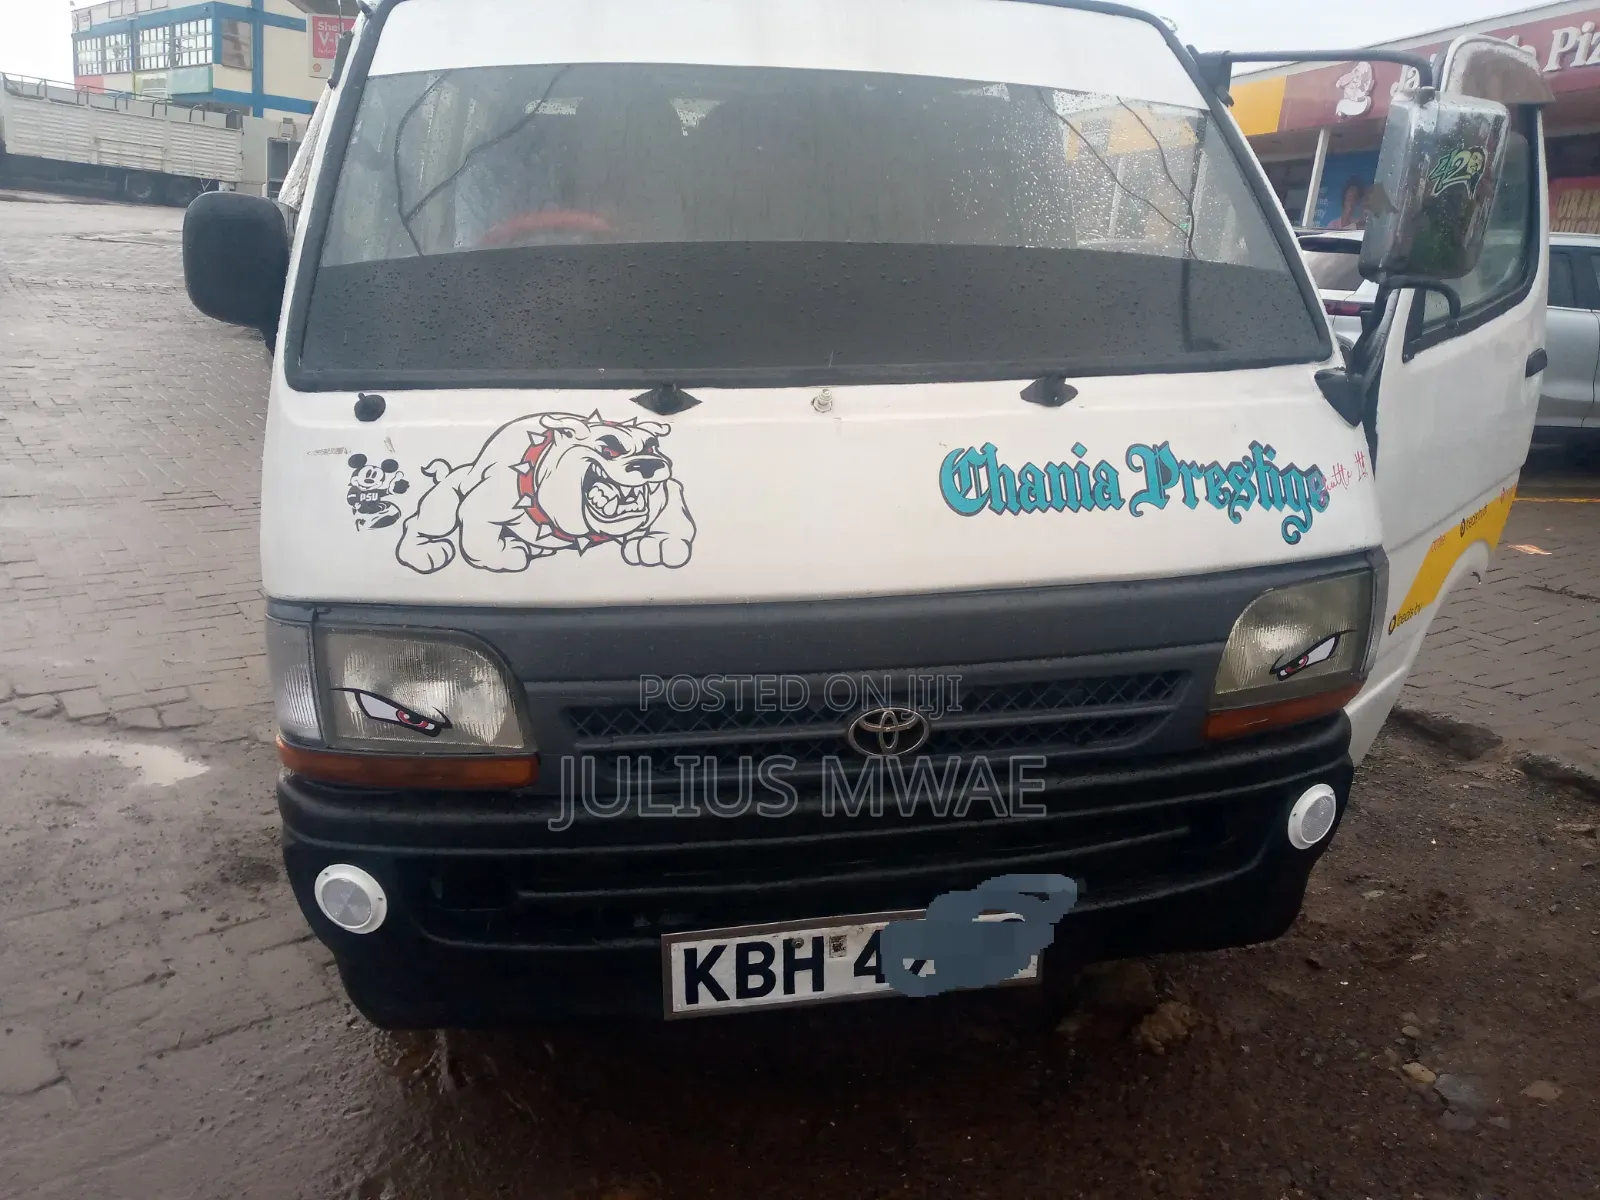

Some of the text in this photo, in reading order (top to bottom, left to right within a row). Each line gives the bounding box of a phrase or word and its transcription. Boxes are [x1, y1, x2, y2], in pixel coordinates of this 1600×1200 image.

[318, 20, 345, 32] Shell
[360, 492, 379, 502] PSU
[938, 440, 1331, 545] Chania Prestige
[684, 936, 825, 1006] KBH
